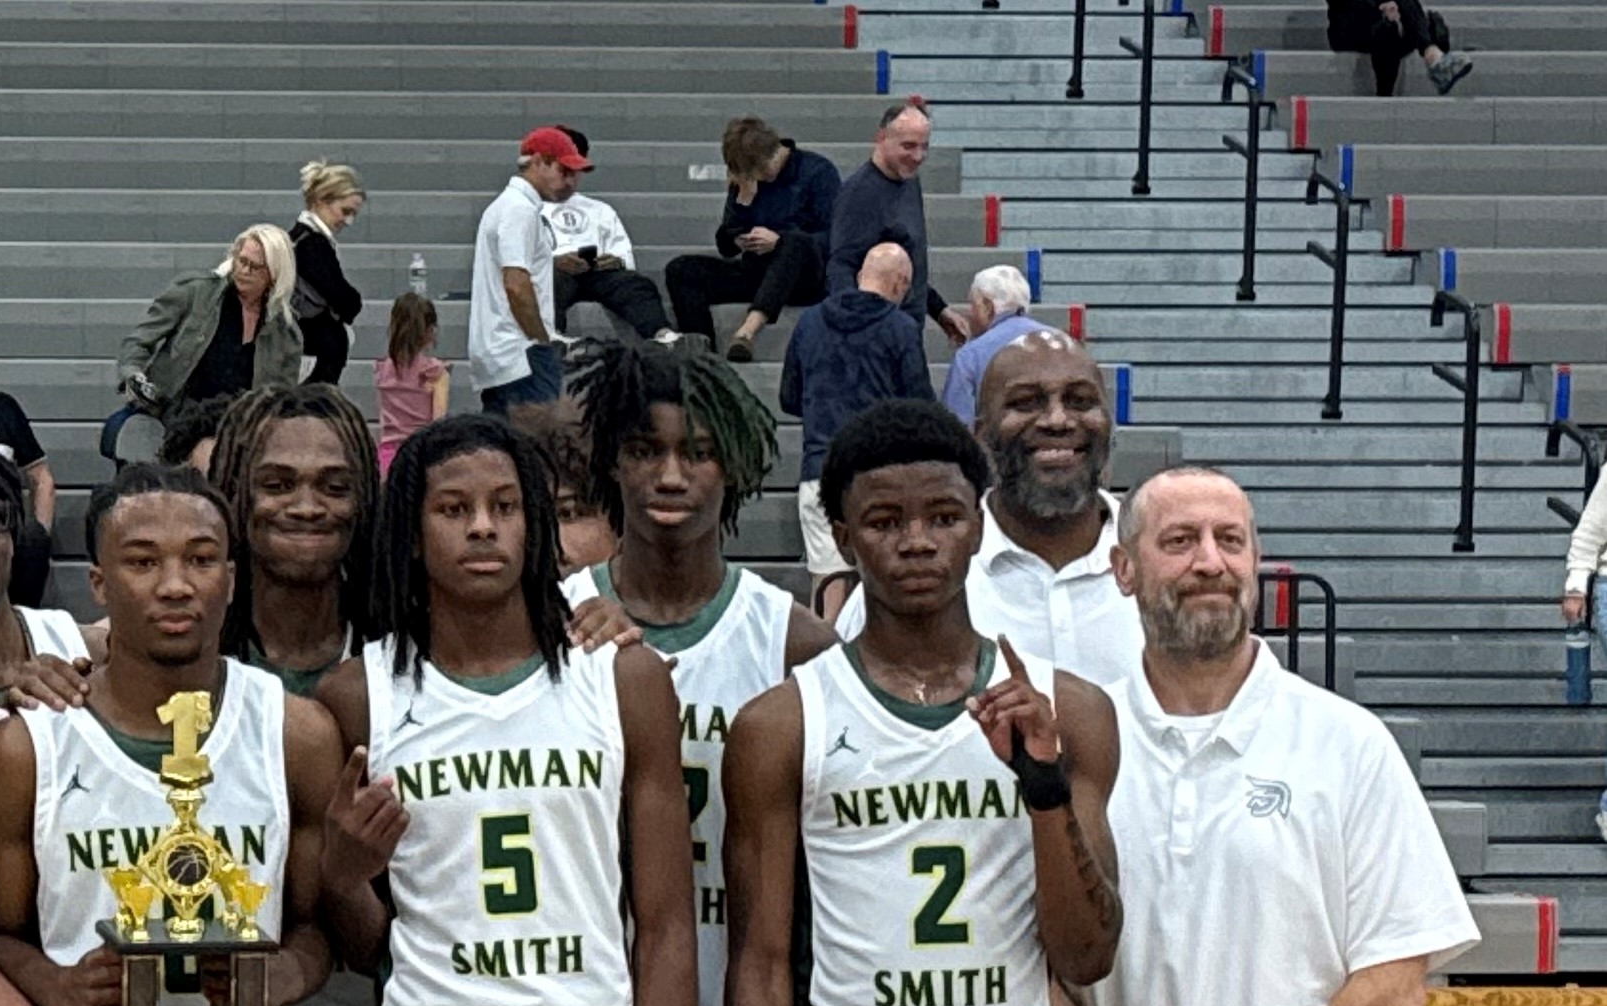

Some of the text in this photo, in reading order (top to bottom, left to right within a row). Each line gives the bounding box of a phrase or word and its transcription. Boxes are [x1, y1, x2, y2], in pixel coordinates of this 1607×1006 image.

[394, 748, 604, 803] NEWMAN
[66, 824, 266, 873] NEWAN
[477, 810, 544, 919] 5
[909, 841, 974, 949] 2
[451, 935, 584, 978] SMITH
